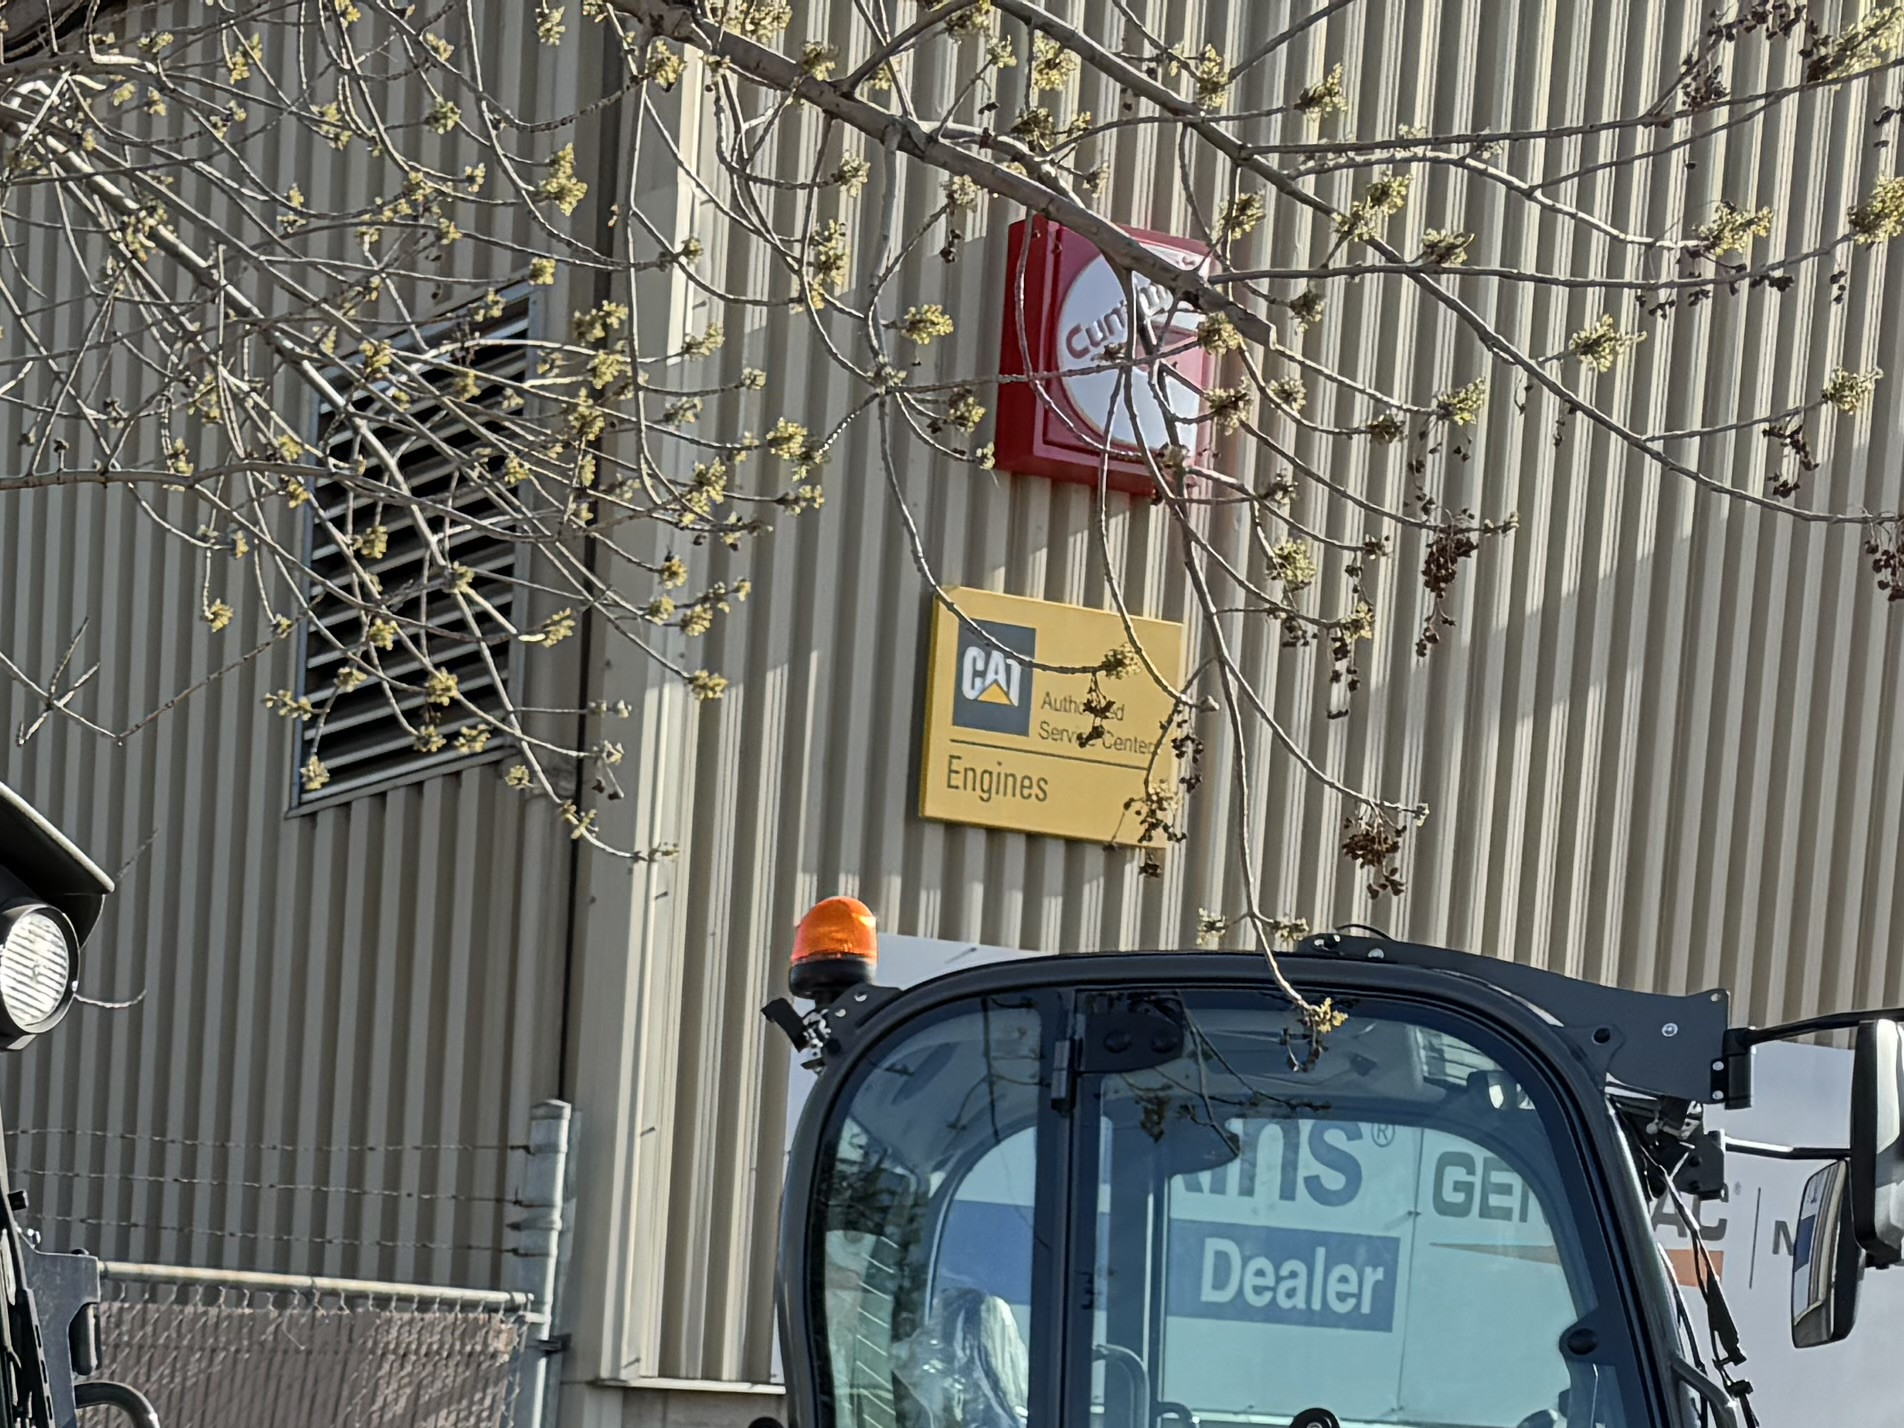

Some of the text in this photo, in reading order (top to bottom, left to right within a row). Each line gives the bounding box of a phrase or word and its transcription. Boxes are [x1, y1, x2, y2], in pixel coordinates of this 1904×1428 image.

[962, 646, 1022, 707] CAT
[1041, 691, 1125, 721] Authod
[1038, 720, 1096, 747] Serv
[947, 754, 1049, 802] Engines
[1200, 1237, 1384, 1314] Dealer
